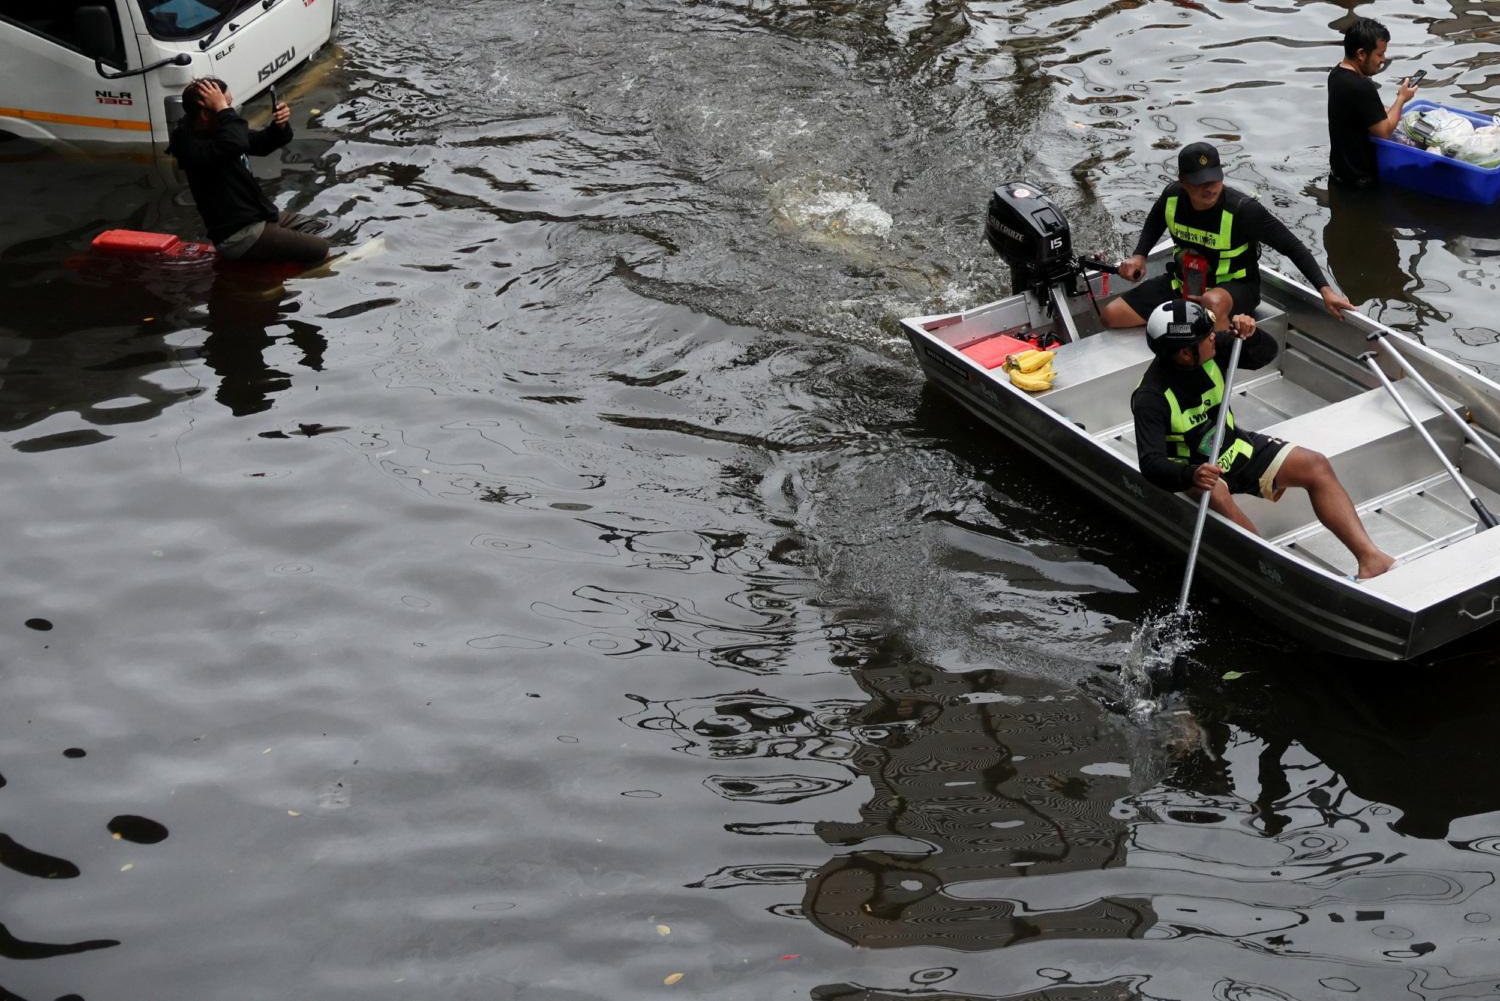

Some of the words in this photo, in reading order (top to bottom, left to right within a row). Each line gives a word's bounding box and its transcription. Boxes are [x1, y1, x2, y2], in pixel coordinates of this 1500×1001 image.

[215, 43, 235, 61] ELF
[258, 46, 295, 83] ISUZU
[95, 89, 131, 99] NLR
[97, 98, 133, 106] 130
[1050, 237, 1063, 250] 15
